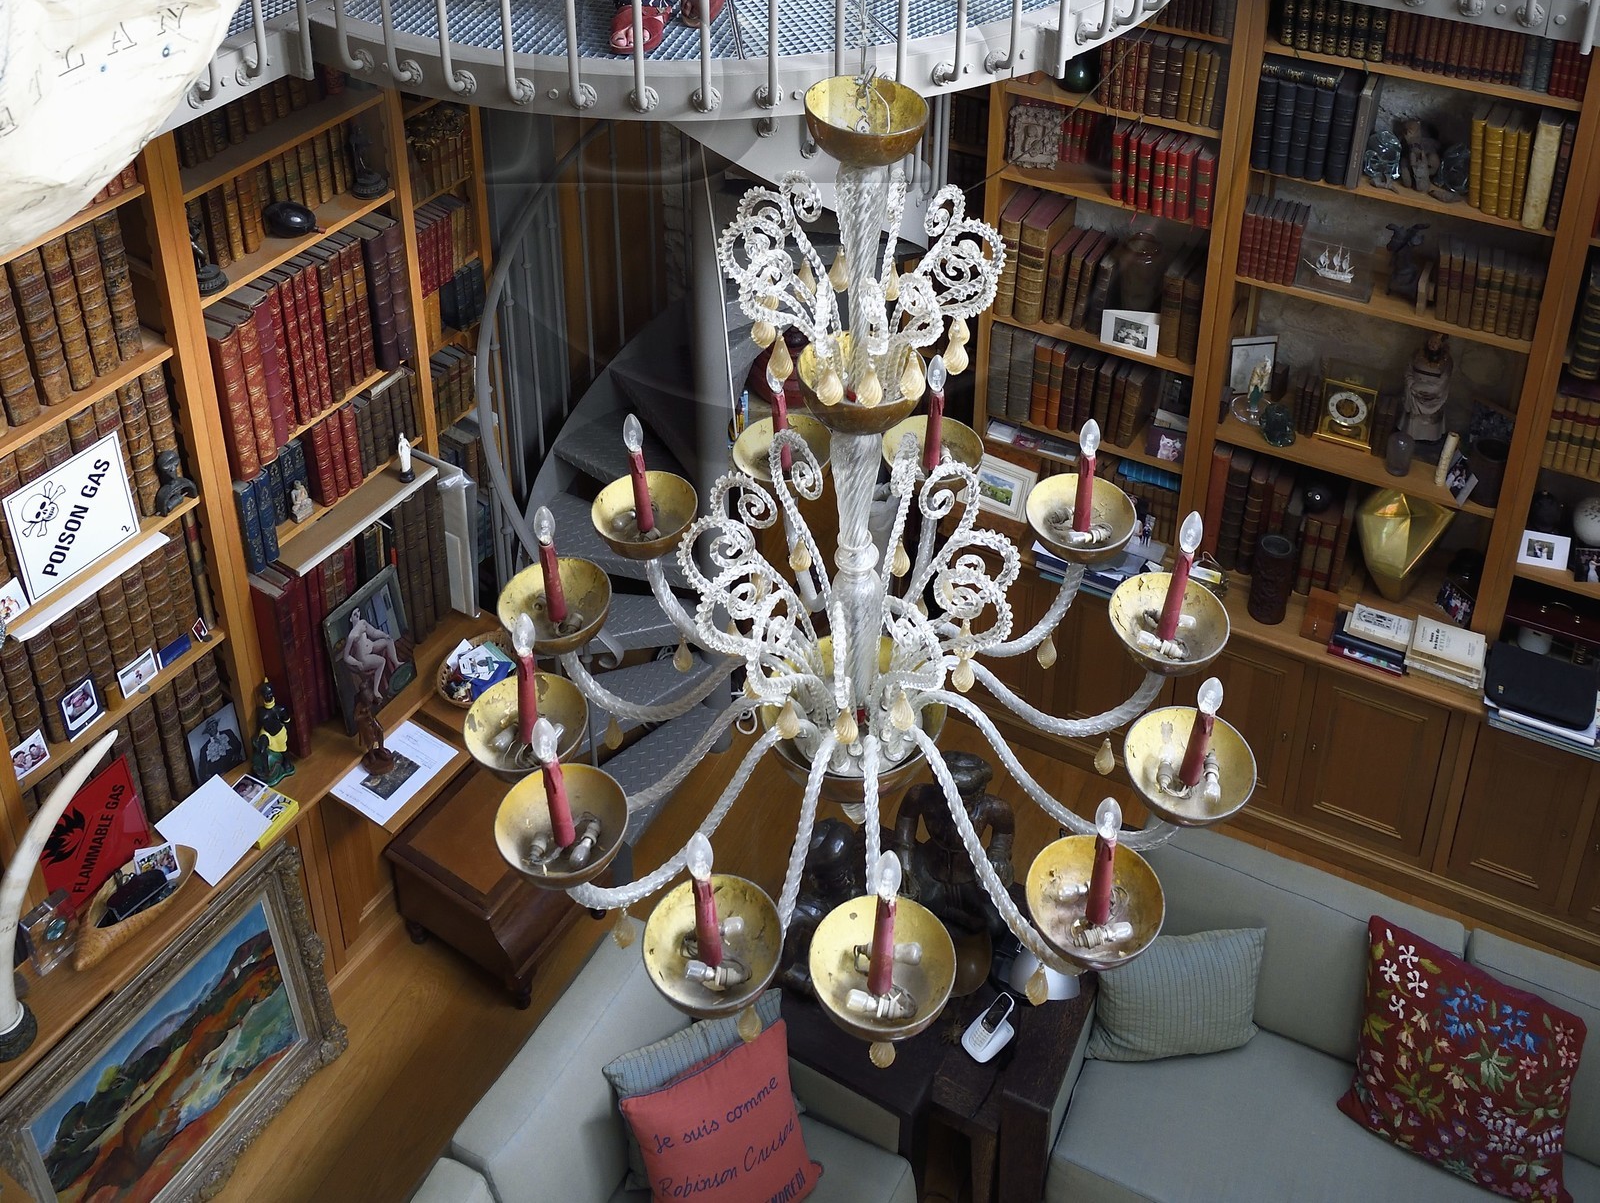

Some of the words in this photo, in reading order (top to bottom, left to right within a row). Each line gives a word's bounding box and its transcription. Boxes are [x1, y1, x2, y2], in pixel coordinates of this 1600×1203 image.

[42, 504, 90, 577] POISON
[80, 458, 111, 499] GAS
[121, 524, 131, 533] 2
[72, 810, 116, 894] FLAMMABLE
[106, 783, 126, 811] GAS
[133, 837, 144, 846] 2
[653, 1133, 676, 1155] Je
[683, 1120, 721, 1144] suis
[726, 1075, 779, 1124] comme
[658, 1166, 738, 1199] Robinson
